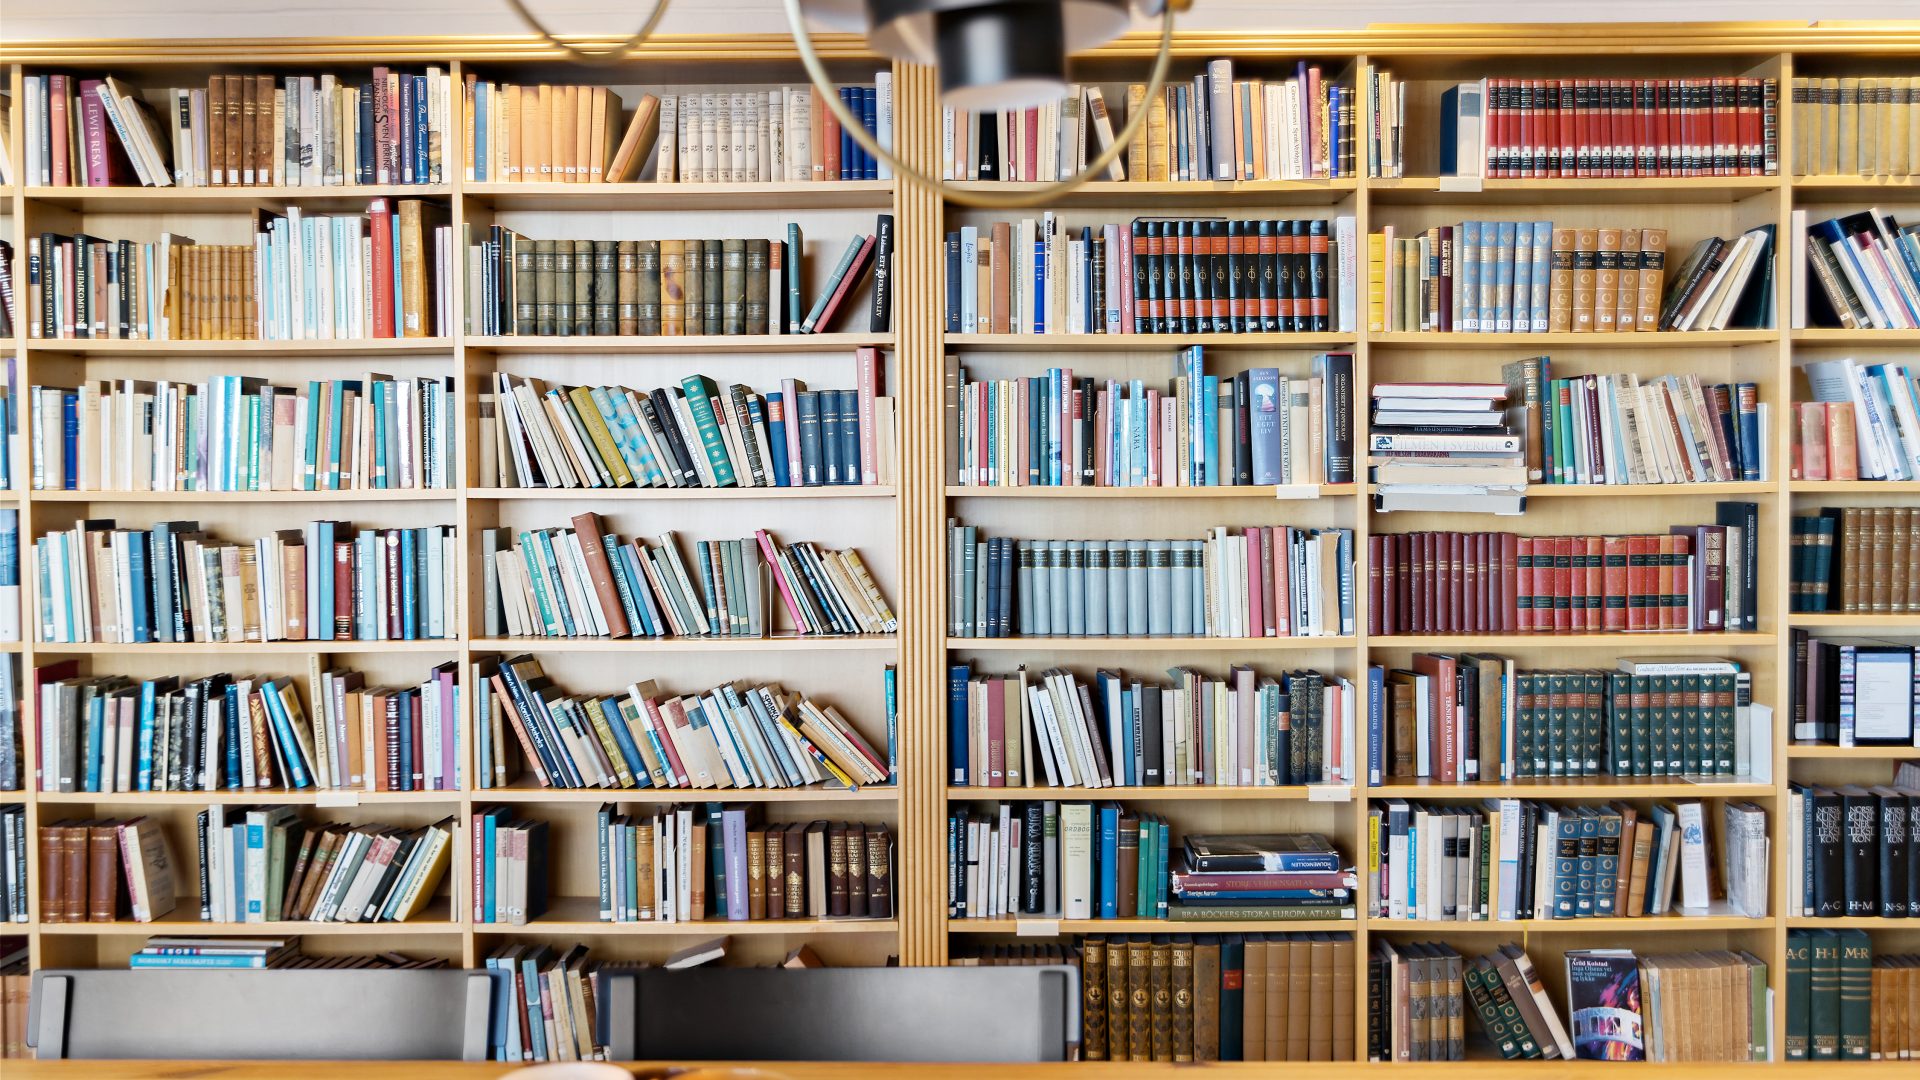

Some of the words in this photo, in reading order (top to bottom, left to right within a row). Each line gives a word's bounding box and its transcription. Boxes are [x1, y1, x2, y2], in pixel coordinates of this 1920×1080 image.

[88, 103, 101, 138] LEWIS
[90, 140, 101, 167] RESA
[45, 269, 54, 300] SVENSK
[76, 269, 85, 325] HEMKOMSTEN
[45, 302, 55, 335] SOLDAT
[1133, 425, 1142, 451] NÄRA
[1371, 679, 1379, 702] JOSTEIN
[1445, 695, 1453, 724] TEKNIKK
[1445, 725, 1453, 733] PÅ
[1371, 733, 1379, 770] JULEMYSTER
[17, 816, 25, 837] Kerstin
[1821, 835, 1839, 843] KON
[1852, 835, 1871, 843] KON
[1182, 910, 1198, 918] BRA
[1201, 909, 1240, 918] BÖCKERS
[1850, 901, 1873, 910] H-M
[1844, 948, 1869, 958] M-R
